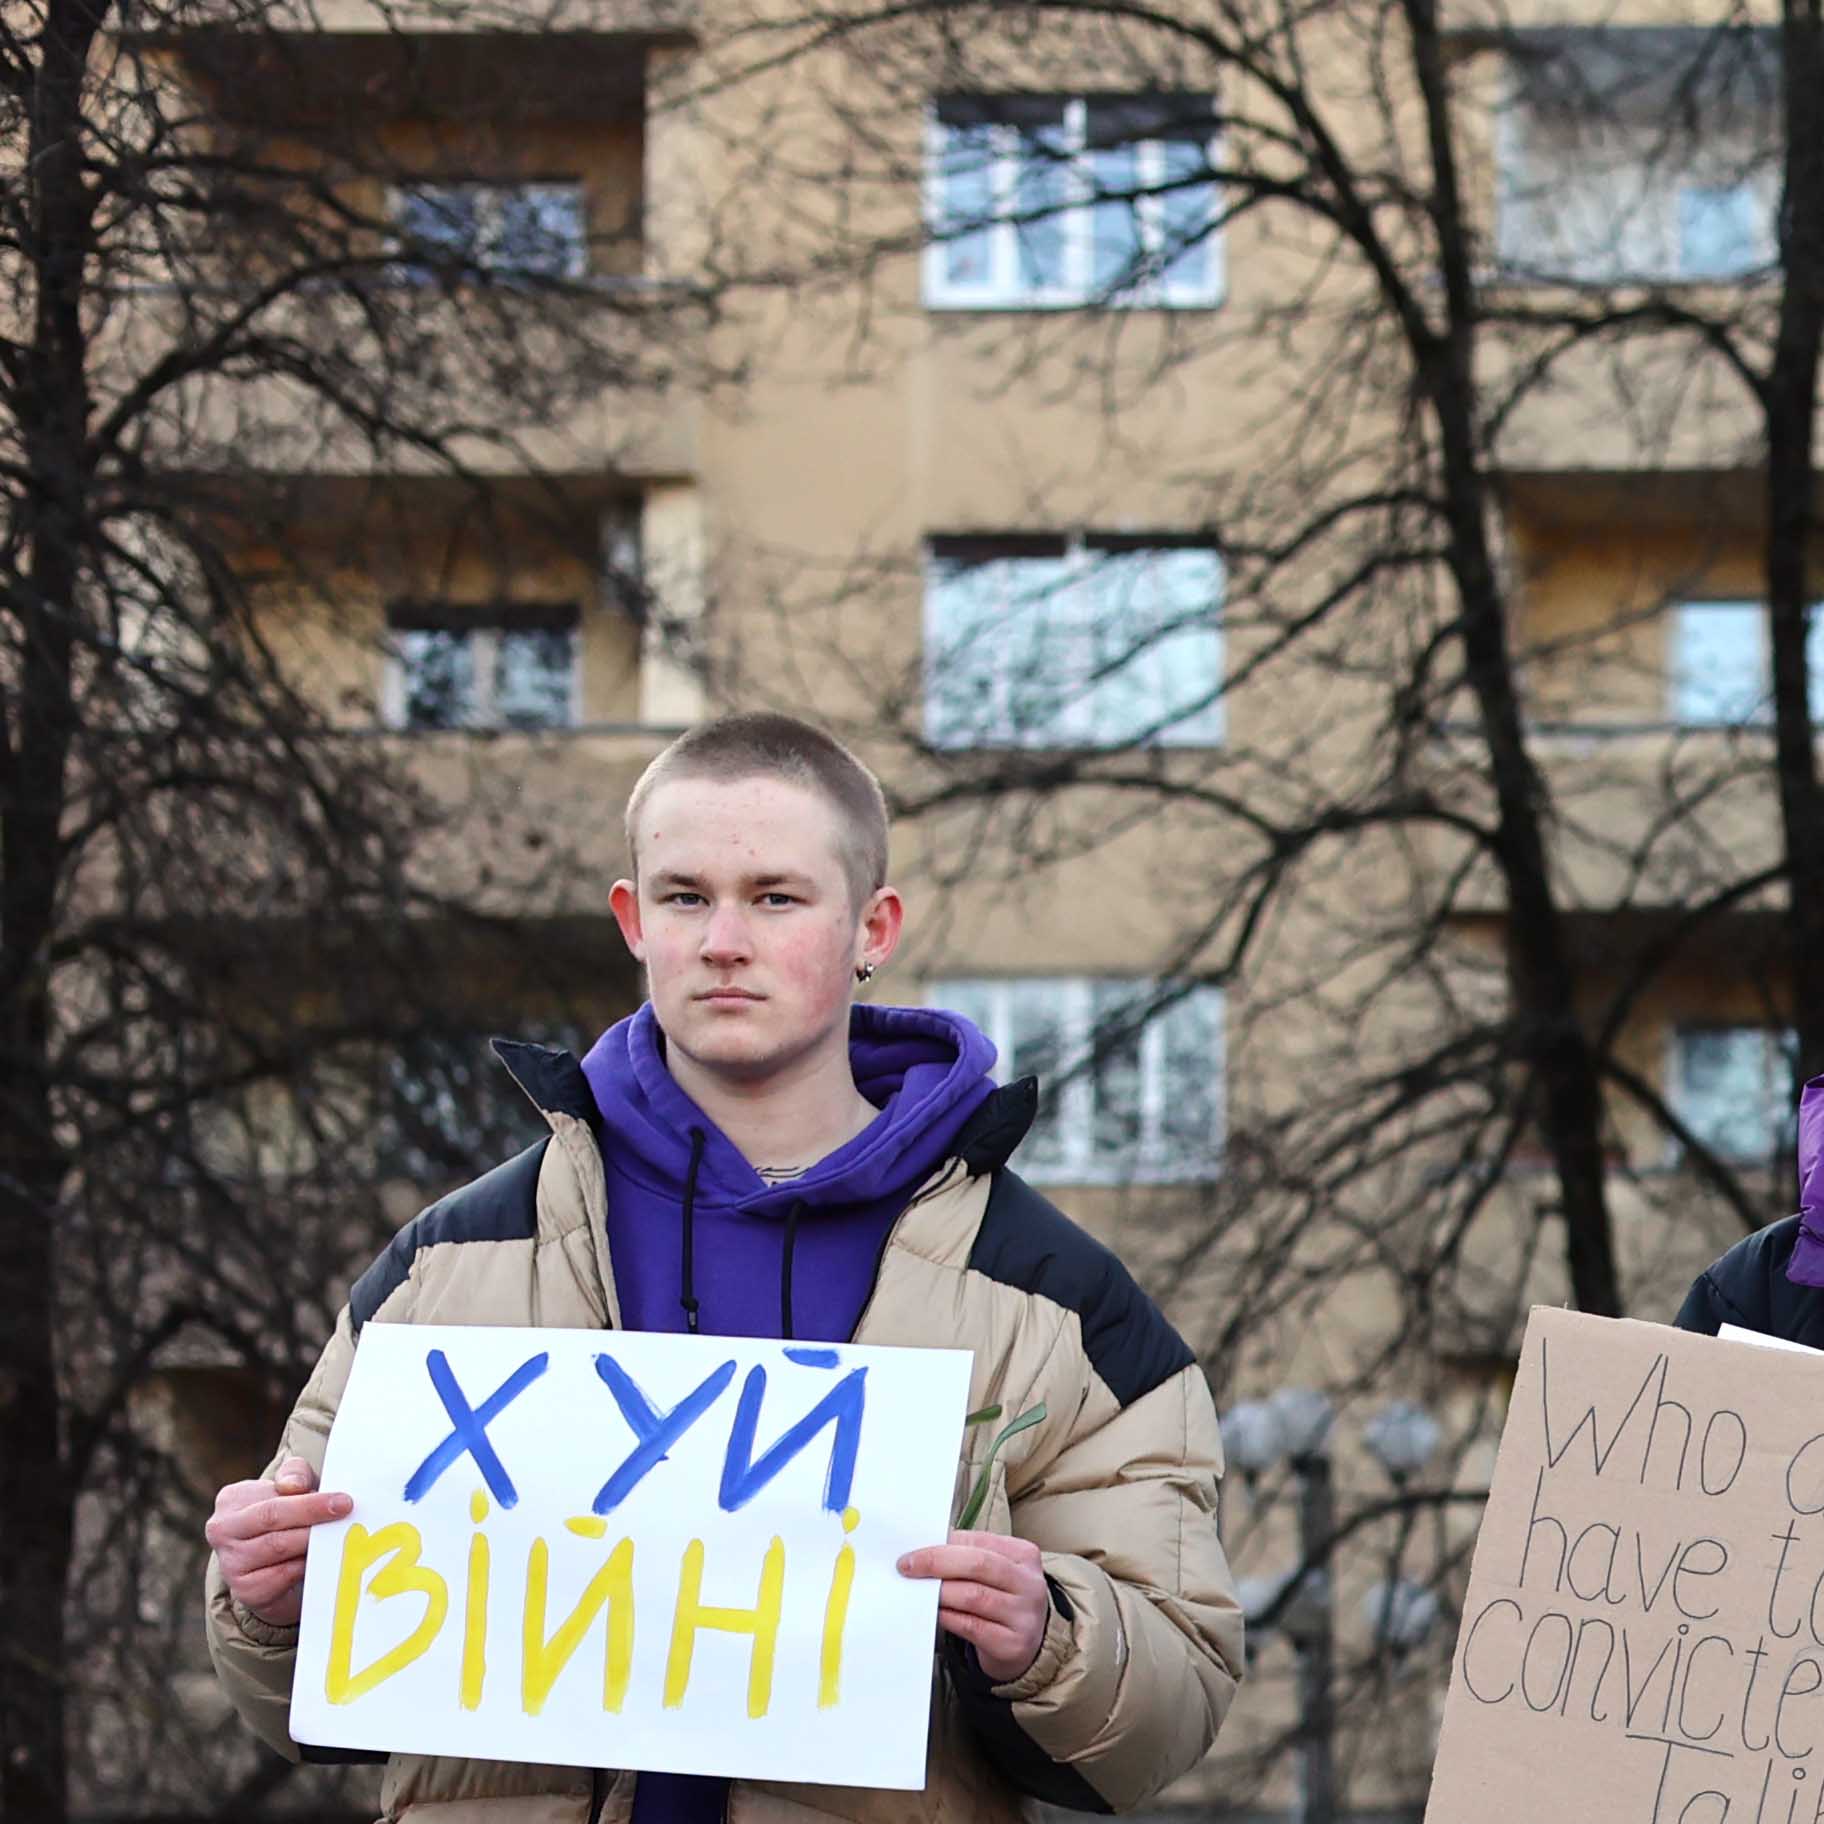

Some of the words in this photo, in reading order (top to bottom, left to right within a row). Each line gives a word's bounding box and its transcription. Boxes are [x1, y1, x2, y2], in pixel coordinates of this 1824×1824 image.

[403, 1346, 869, 1515] ХУЙ
[1540, 1336, 1748, 1497] Who
[324, 1487, 860, 1721] ВІЙНІ
[1519, 1464, 1729, 1620] have
